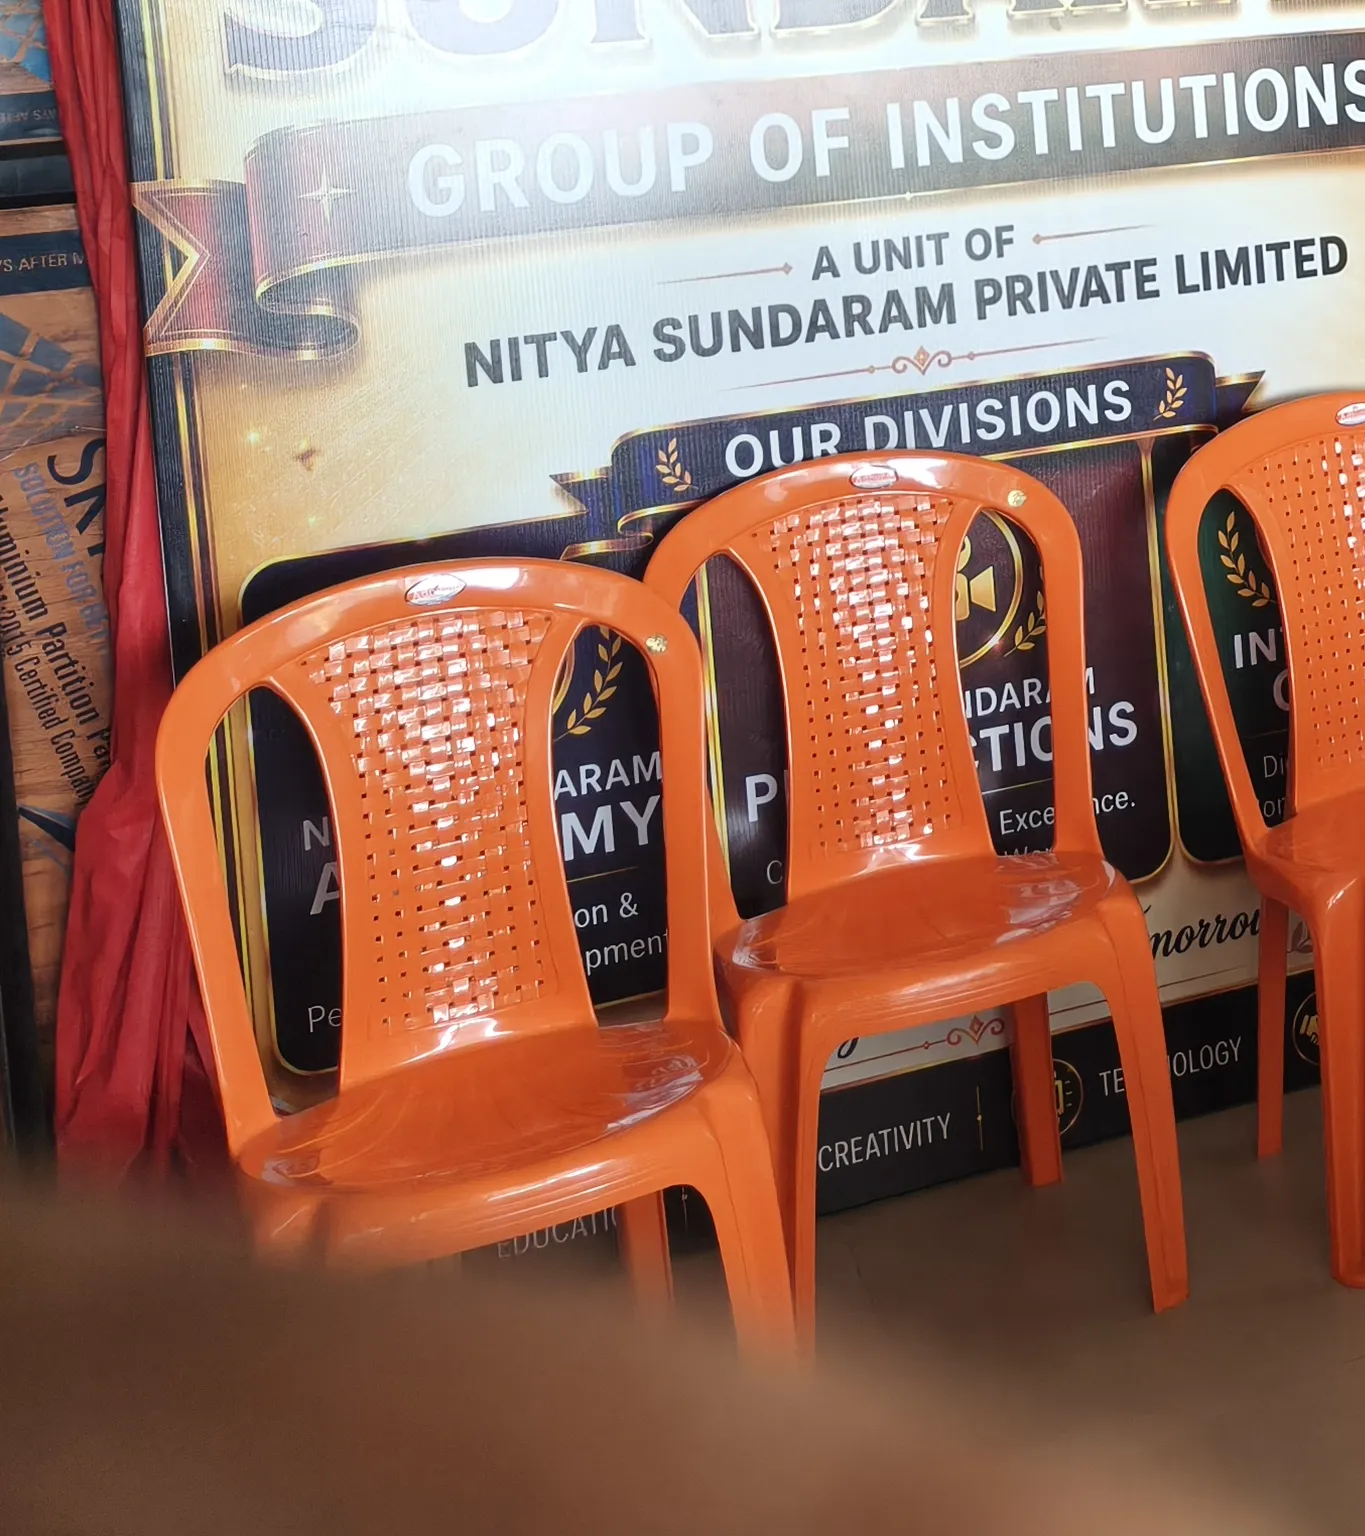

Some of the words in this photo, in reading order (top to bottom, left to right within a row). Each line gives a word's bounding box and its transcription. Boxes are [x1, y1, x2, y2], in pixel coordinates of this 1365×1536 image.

[408, 120, 713, 218] GROUP
[749, 107, 850, 183] OF
[811, 246, 841, 280] A
[854, 231, 950, 275] UNIT
[965, 225, 1015, 261] OF
[465, 323, 637, 387] NITYA
[653, 282, 957, 363] SUNDARAM
[975, 257, 1160, 320] PRIVATE
[1175, 234, 1348, 294] LIMITED
[725, 421, 841, 478] OUR
[863, 380, 1132, 451] DIVISIONS
[14, 655, 71, 730] Certified
[34, 621, 100, 725] Partition
[817, 1111, 952, 1173] CREATIVITY
